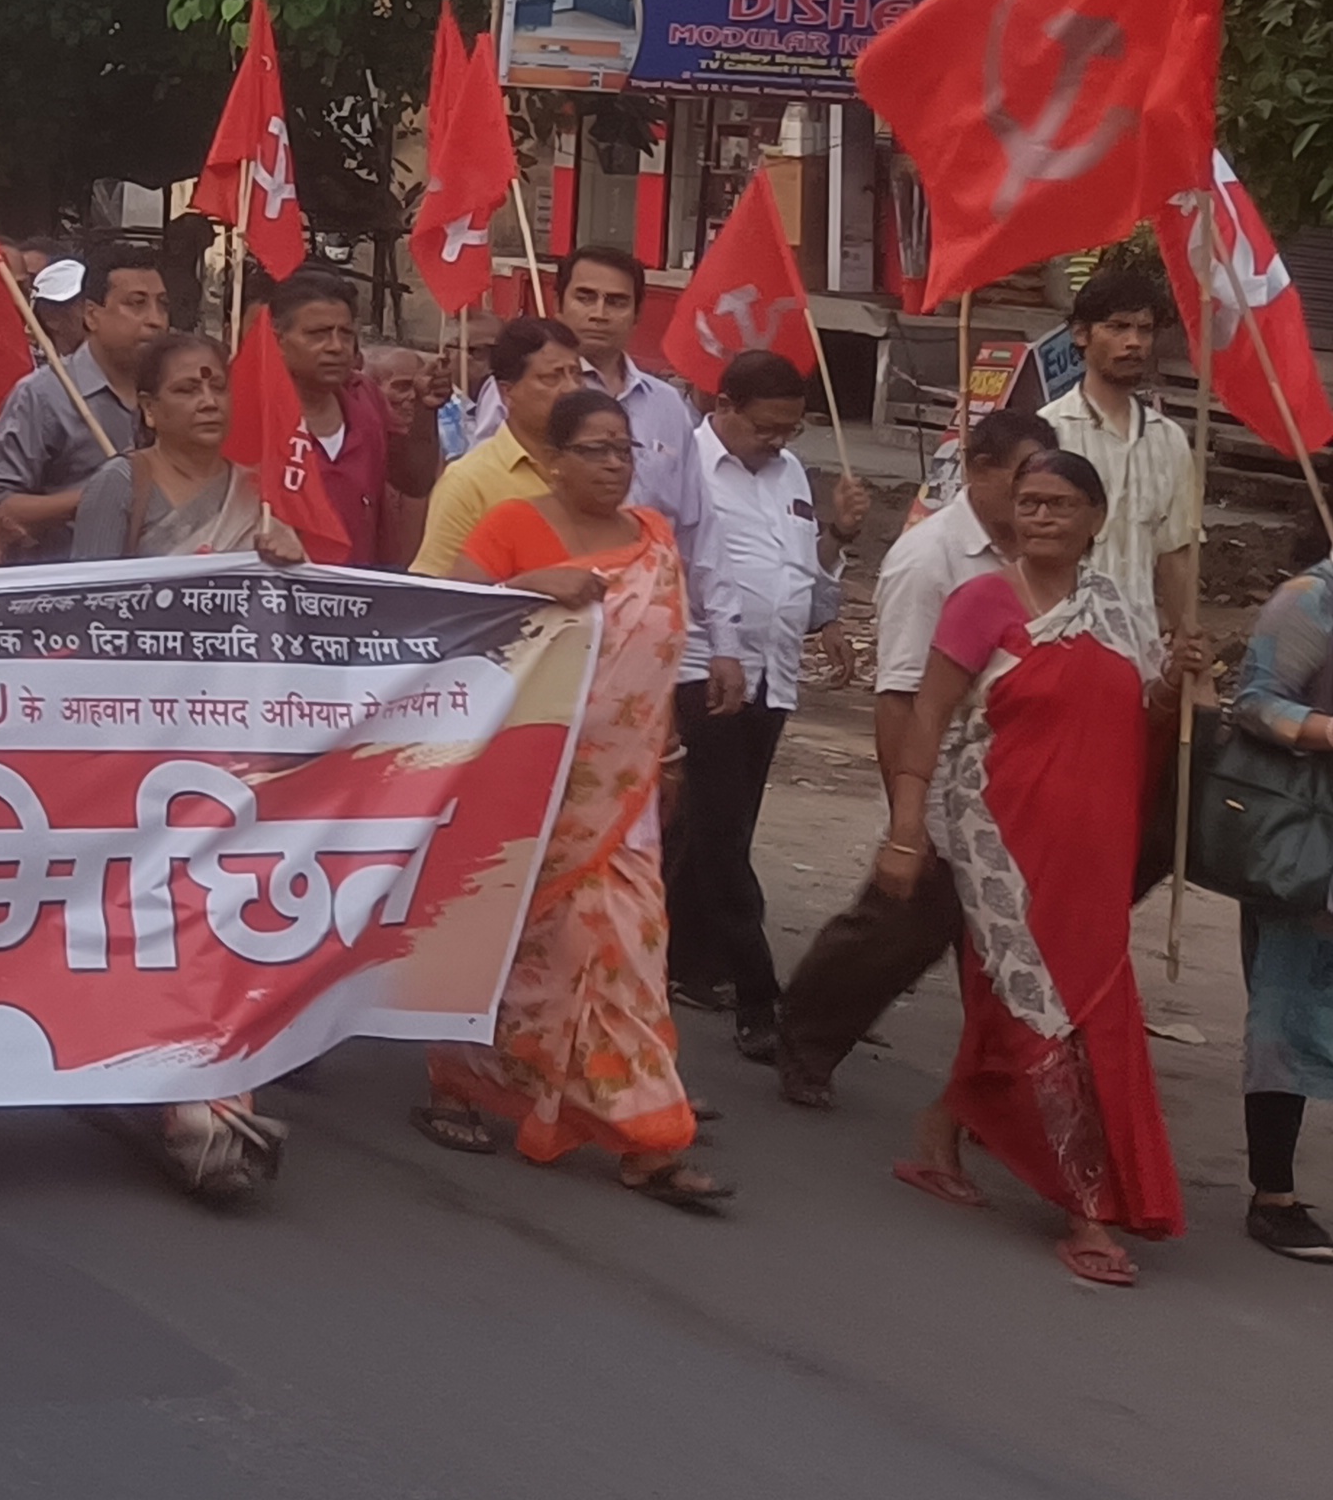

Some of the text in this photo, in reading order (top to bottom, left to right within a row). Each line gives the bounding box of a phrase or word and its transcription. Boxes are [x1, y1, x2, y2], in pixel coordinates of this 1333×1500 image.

[668, 23, 831, 56] MODULAR
[181, 580, 252, 617] महंगाई
[258, 580, 288, 614] के
[292, 585, 373, 618] खिलाफ
[32, 629, 81, 656] २००
[87, 621, 129, 656] दिन
[133, 629, 184, 656] काम
[271, 632, 304, 661] १४
[309, 634, 350, 663] दफा
[355, 629, 401, 662] मांग
[403, 636, 442, 660] पर
[18, 685, 45, 723] के
[150, 697, 179, 726] पर
[187, 690, 249, 729] संसद
[260, 691, 353, 730] अभियान
[448, 680, 469, 717] में
